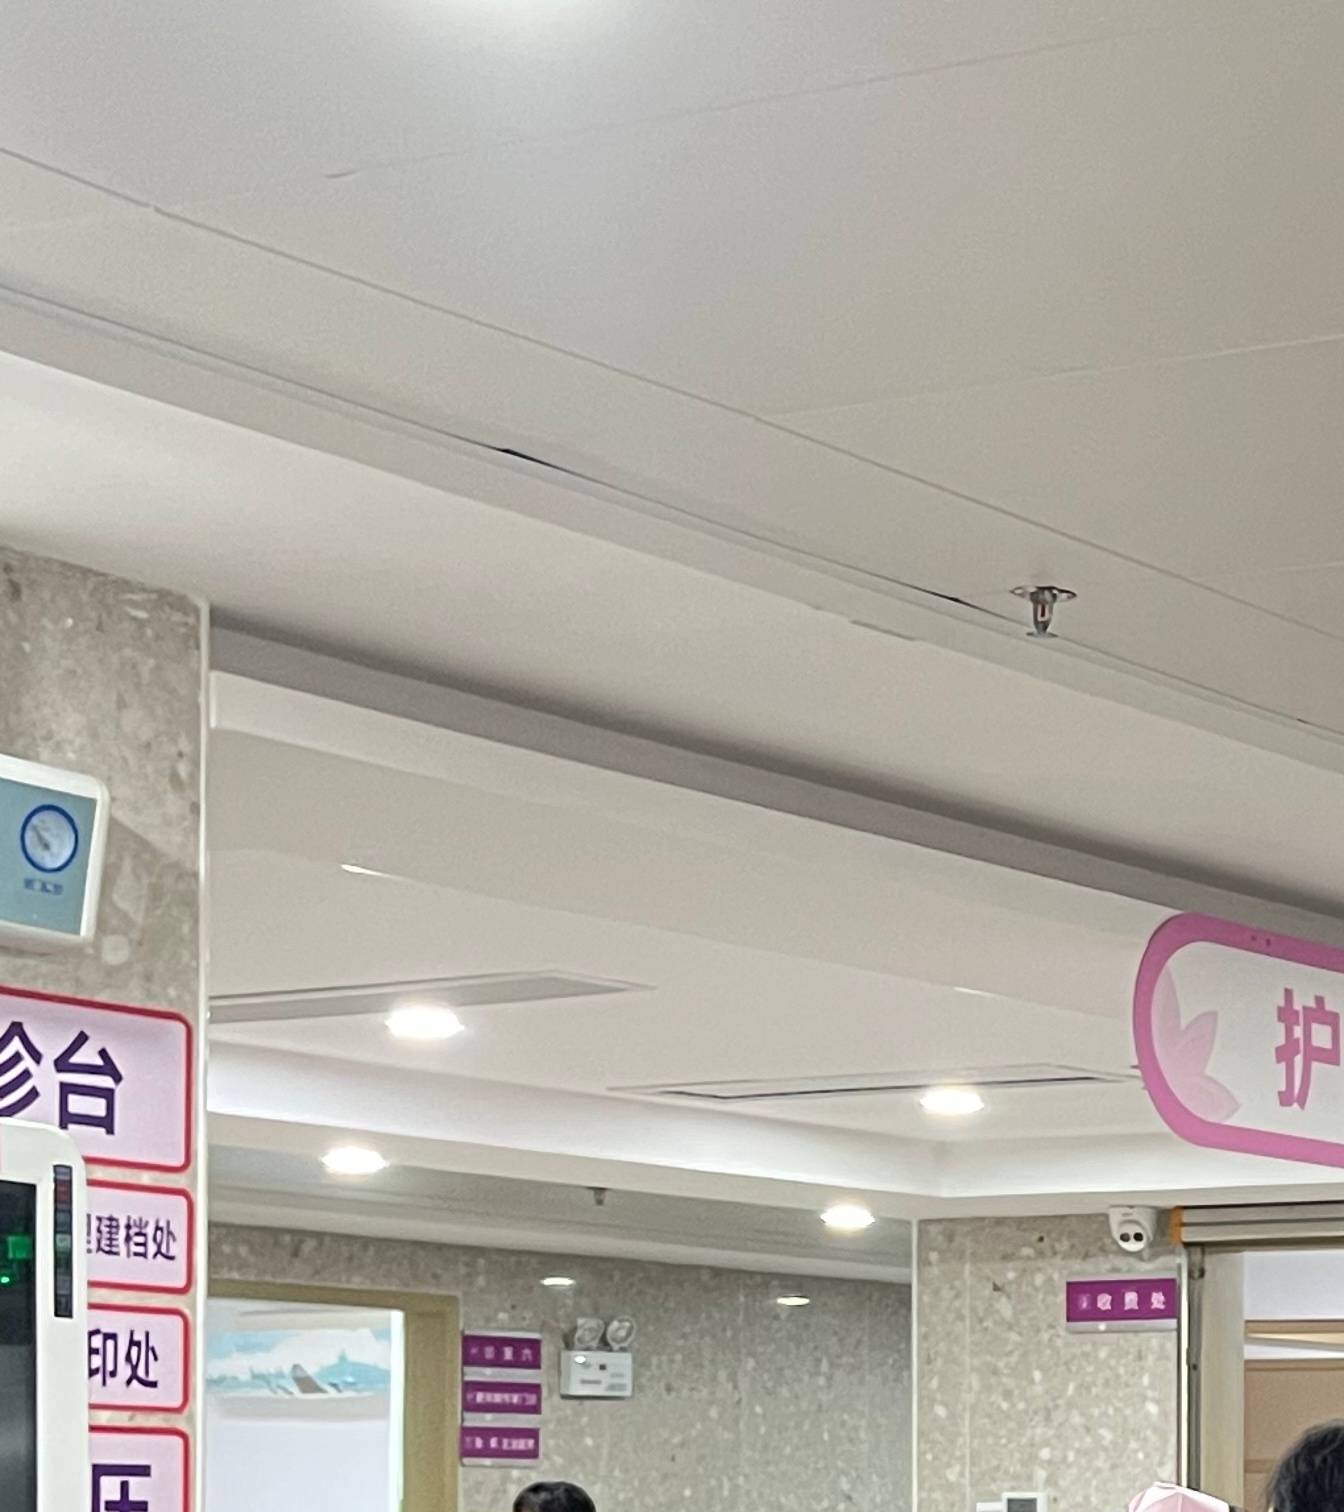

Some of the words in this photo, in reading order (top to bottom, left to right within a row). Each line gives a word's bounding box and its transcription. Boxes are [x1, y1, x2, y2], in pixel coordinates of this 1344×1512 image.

[87, 1213, 176, 1261] 建档处
[88, 1329, 158, 1388] 印处
